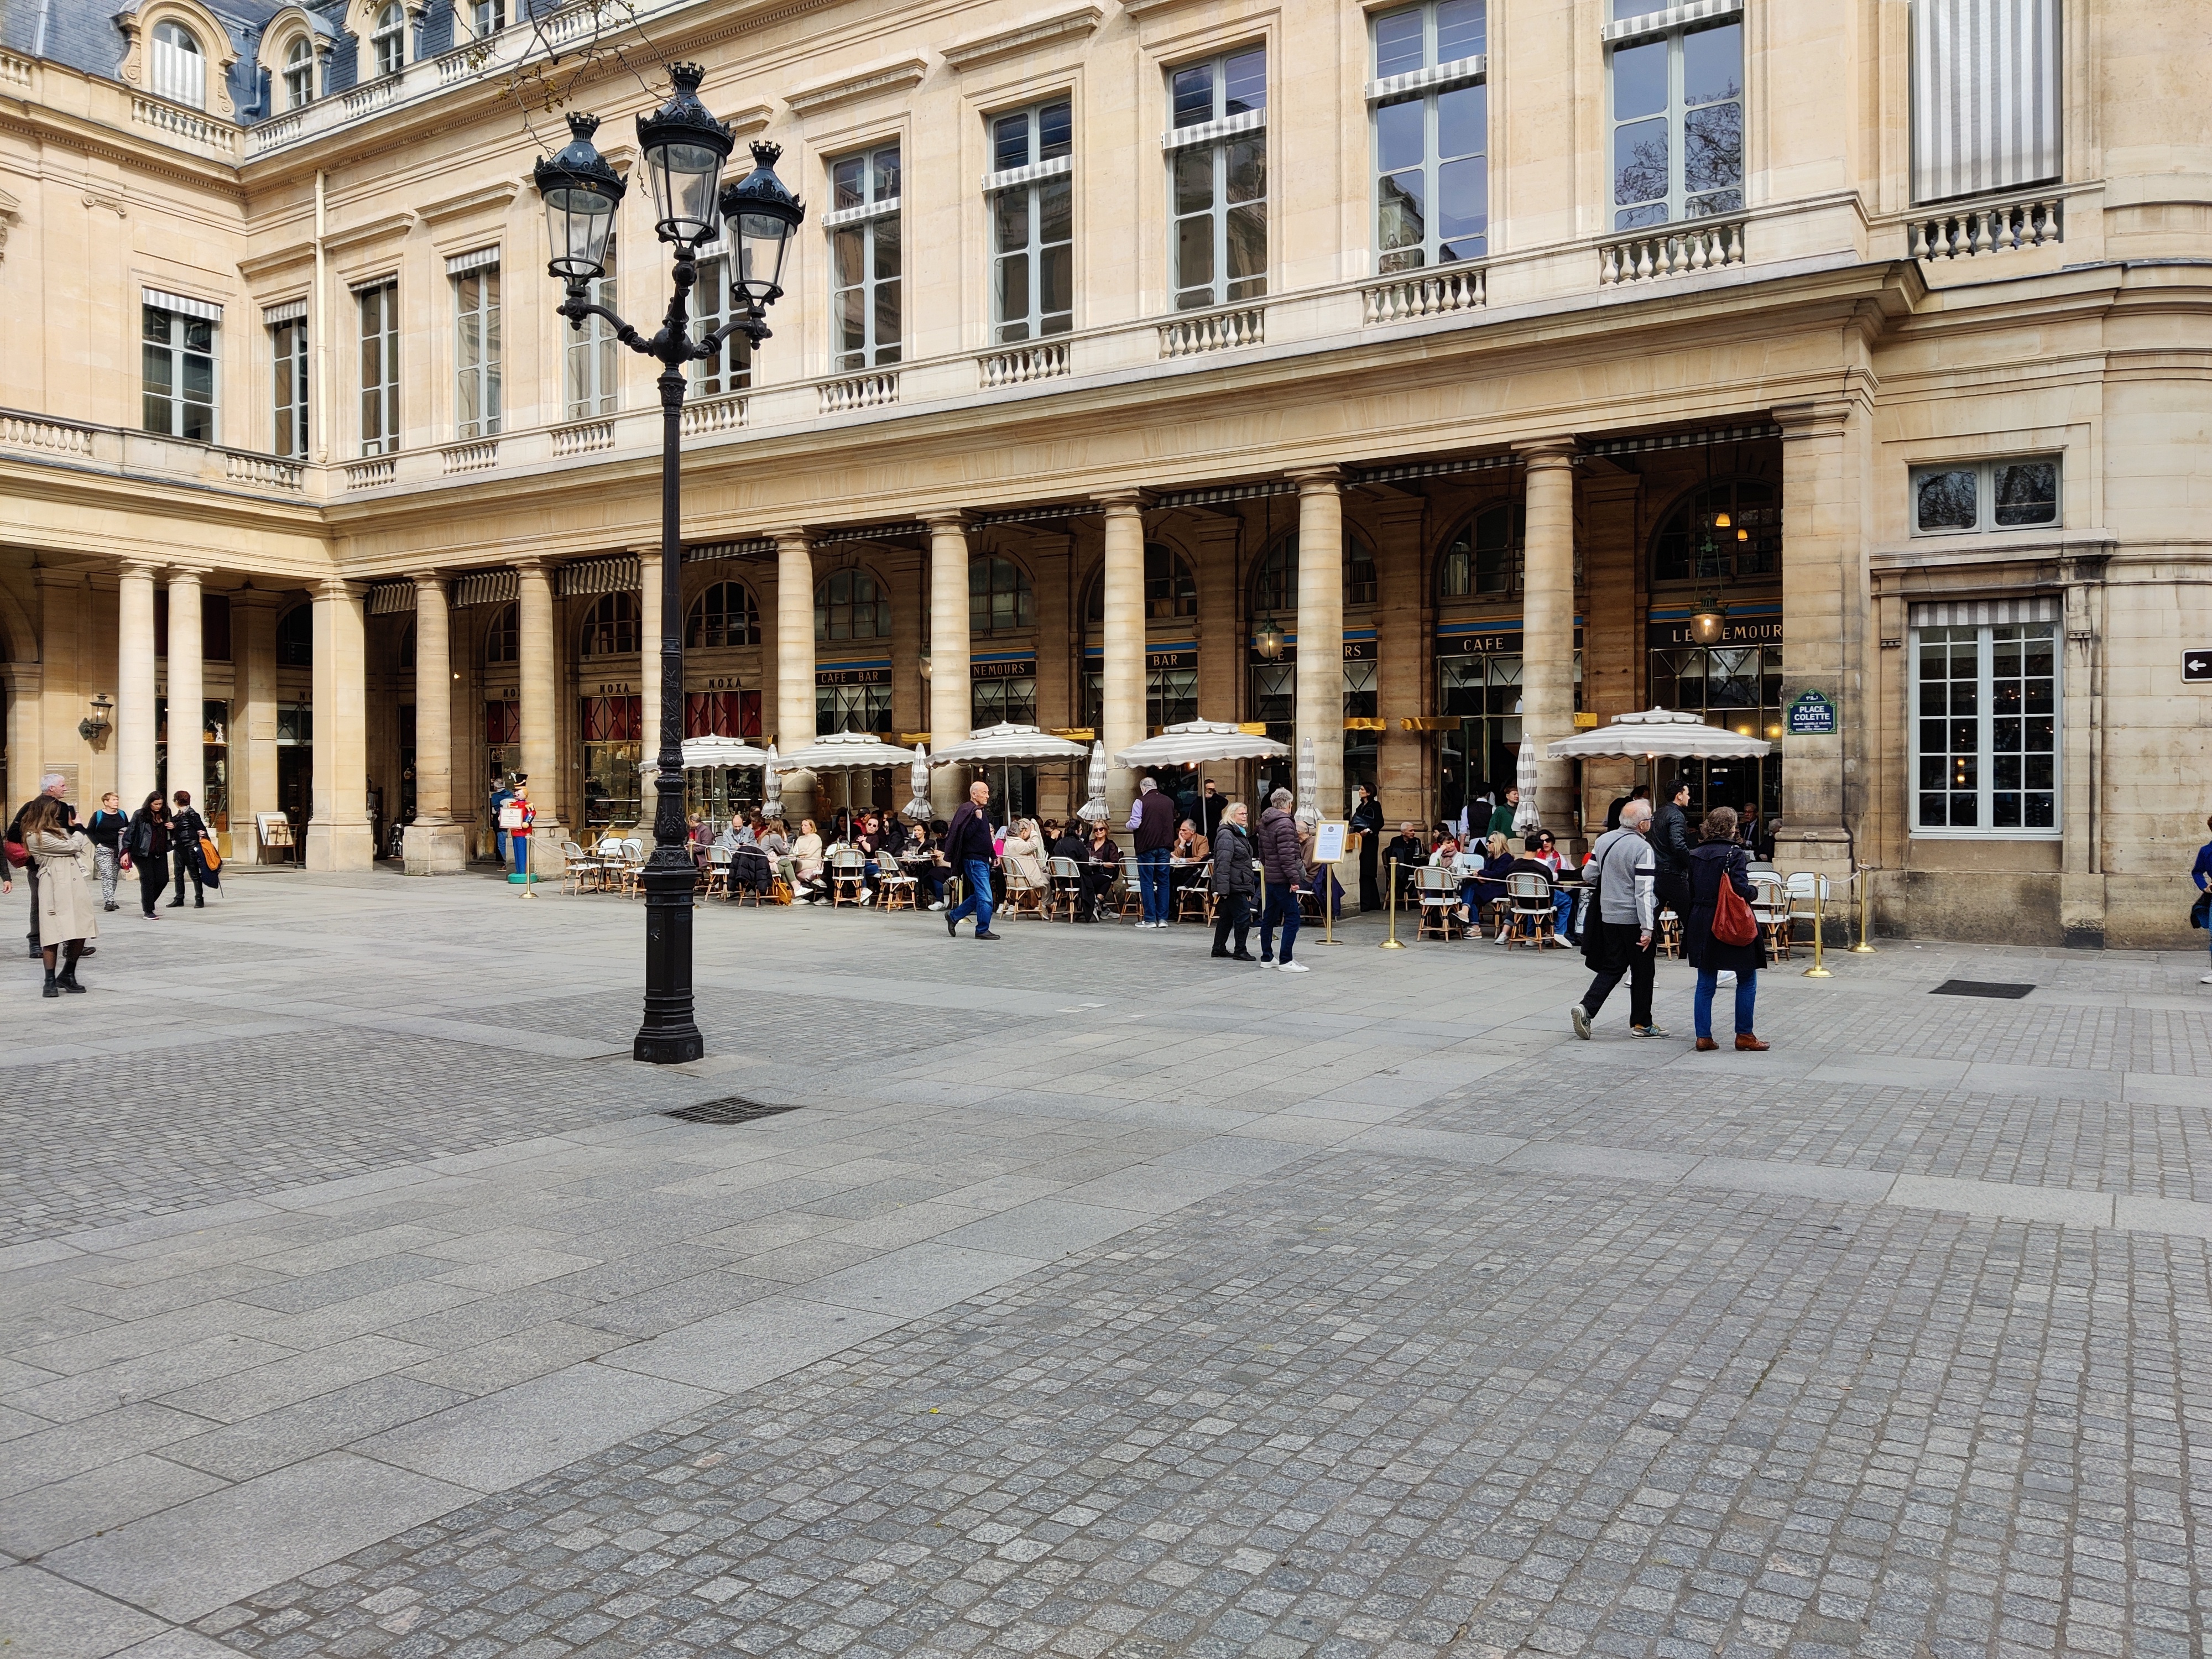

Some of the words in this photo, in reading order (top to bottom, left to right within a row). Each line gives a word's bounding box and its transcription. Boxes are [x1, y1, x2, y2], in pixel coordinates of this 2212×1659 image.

[1722, 624, 1782, 640] EMOUR
[1464, 638, 1505, 651] CAFE
[1154, 655, 1178, 666] BAR
[974, 664, 1025, 676] NEMOURS
[709, 677, 742, 688] NOXA
[821, 673, 847, 683] CAFE
[858, 671, 879, 681] BAR
[503, 688, 520, 697] NO
[599, 683, 630, 693] NOXA
